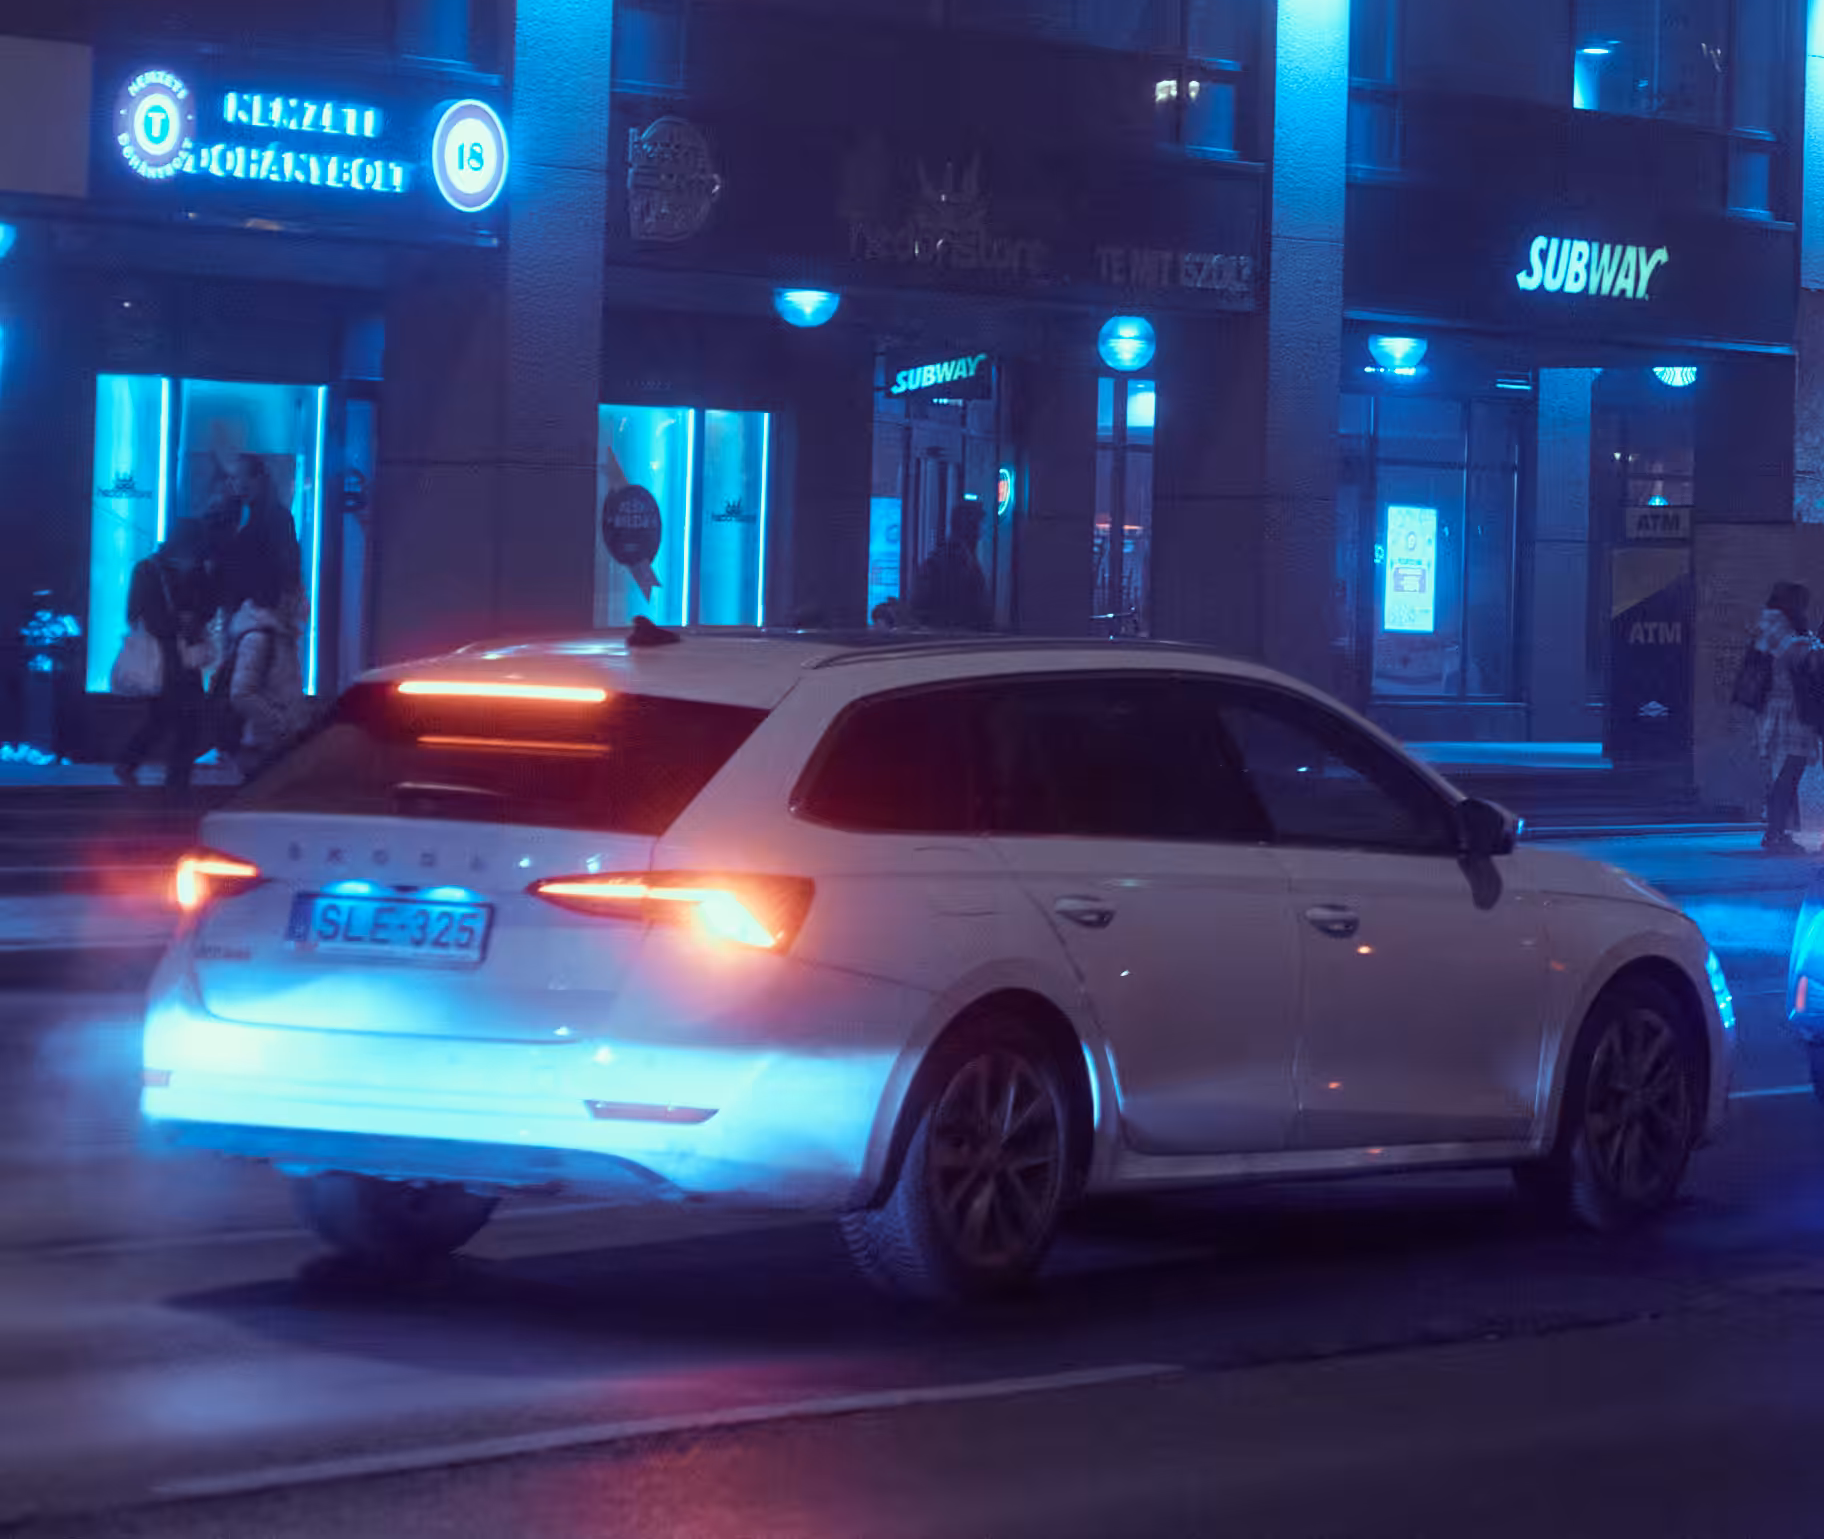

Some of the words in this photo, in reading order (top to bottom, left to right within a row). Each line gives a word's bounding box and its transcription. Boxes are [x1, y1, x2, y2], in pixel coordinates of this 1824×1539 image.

[456, 143, 485, 171] 18
[1516, 235, 1669, 301] SUBWAY
[890, 353, 987, 394] SUBWAY
[1637, 513, 1681, 532] ATM
[1629, 621, 1682, 645] ATM
[317, 904, 479, 949] SLE-325
